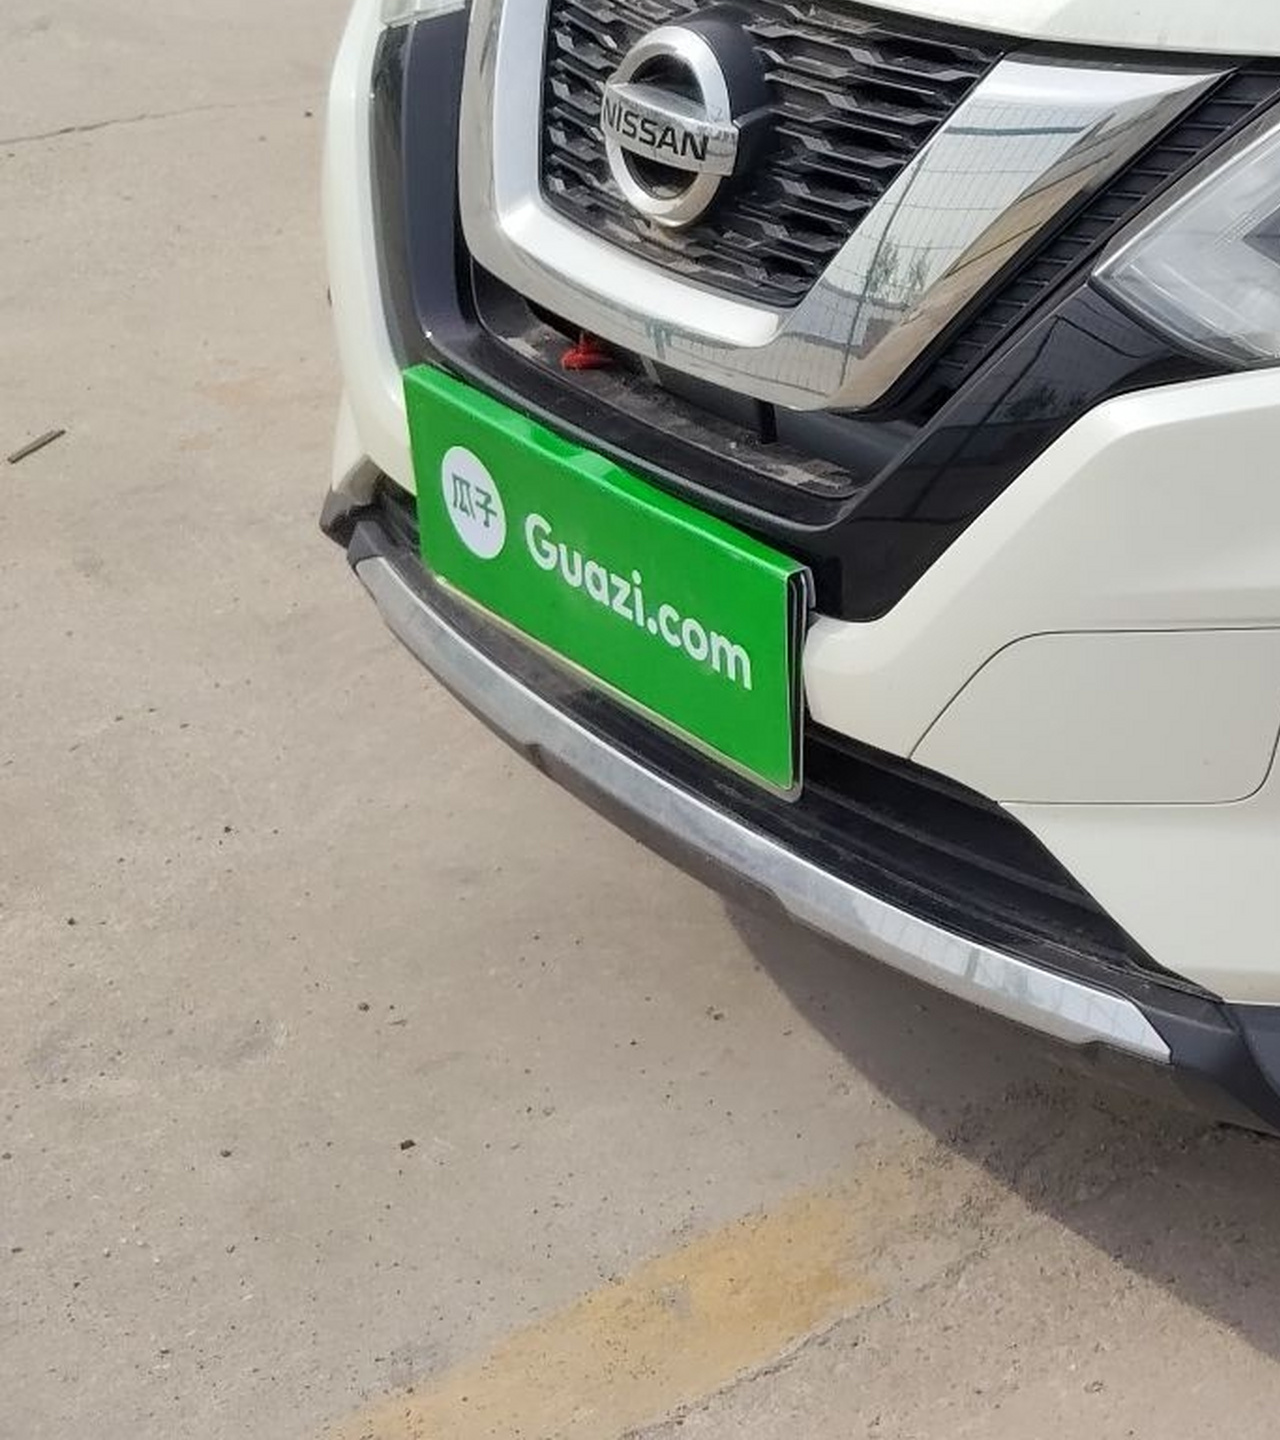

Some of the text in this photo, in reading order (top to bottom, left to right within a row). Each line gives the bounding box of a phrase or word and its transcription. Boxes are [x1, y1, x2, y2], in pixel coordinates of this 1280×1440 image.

[604, 98, 708, 161] NISSAN
[452, 472, 497, 527] 瓜子
[525, 513, 752, 691] Guazi.com
